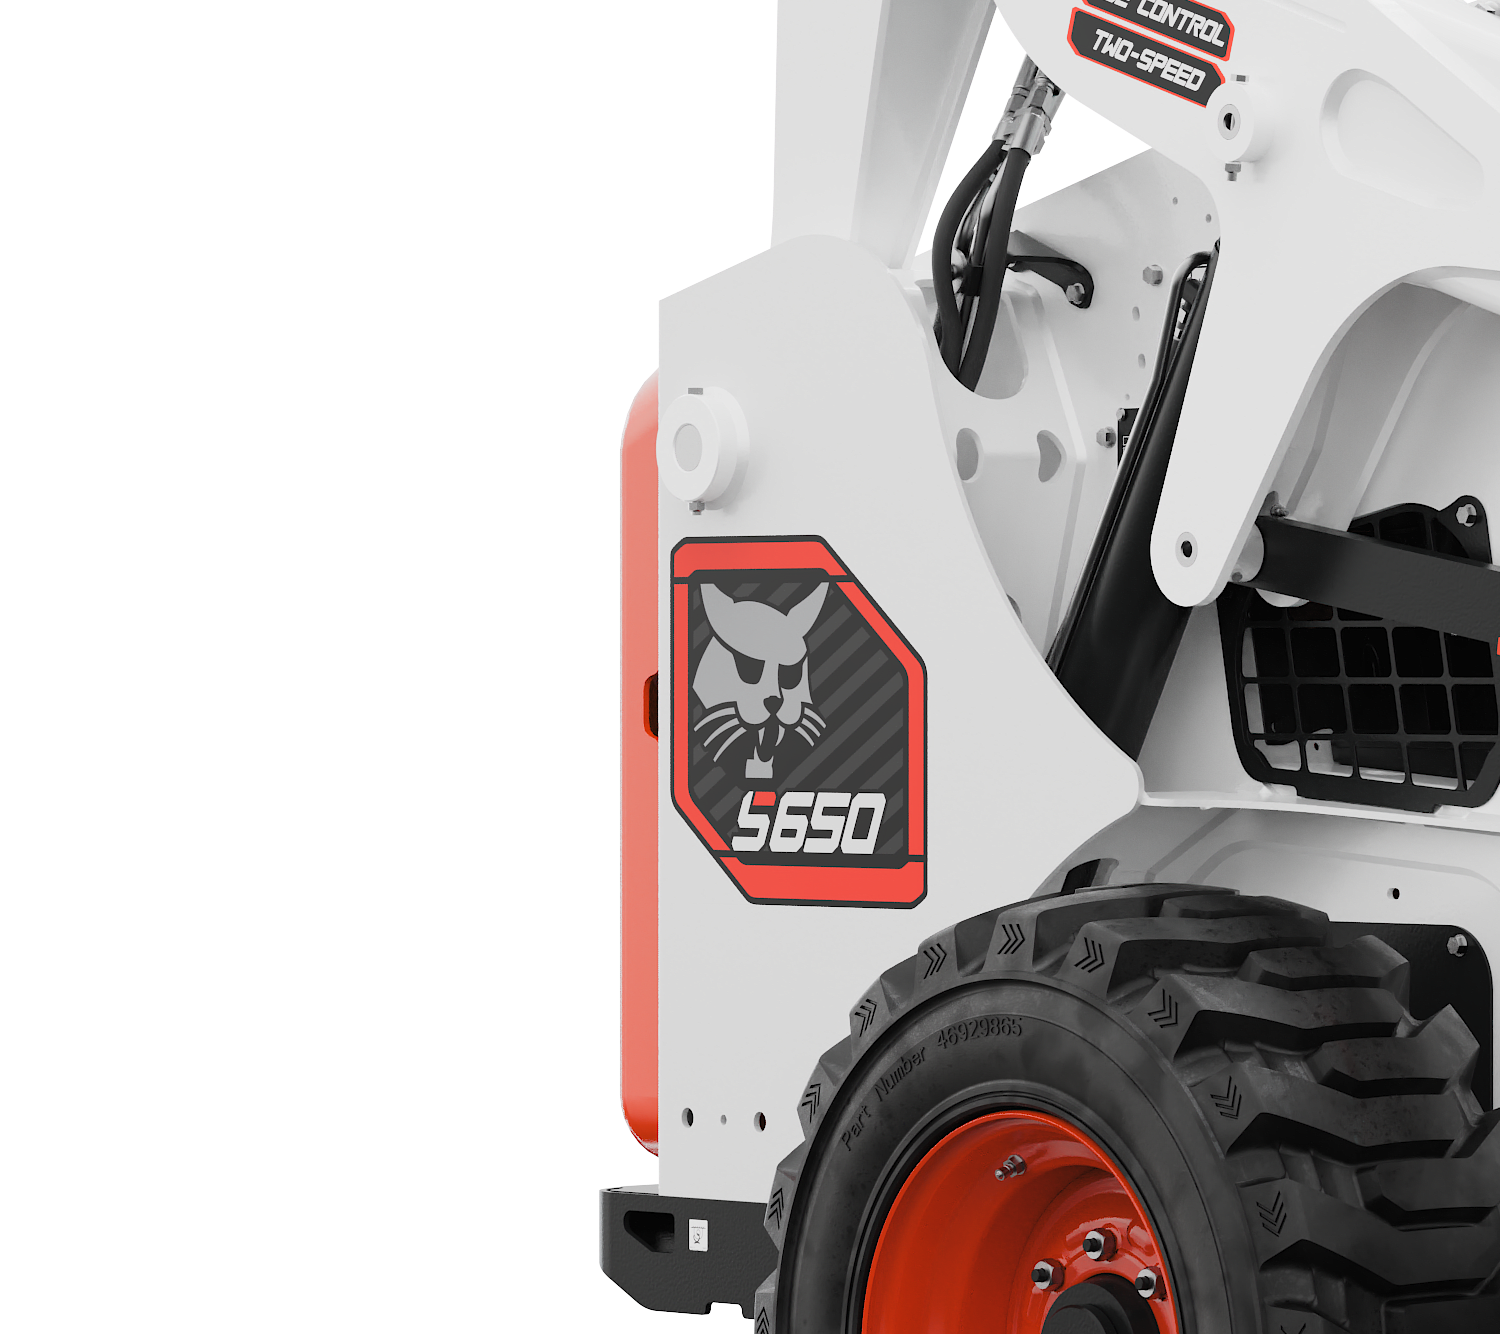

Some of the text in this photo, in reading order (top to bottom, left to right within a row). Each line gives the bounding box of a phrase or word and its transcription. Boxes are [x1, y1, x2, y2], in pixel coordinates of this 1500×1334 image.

[1092, 28, 1206, 92] TWO-SPEED
[731, 790, 887, 855] S650
[841, 1016, 1023, 1152] Part Number 46929865
